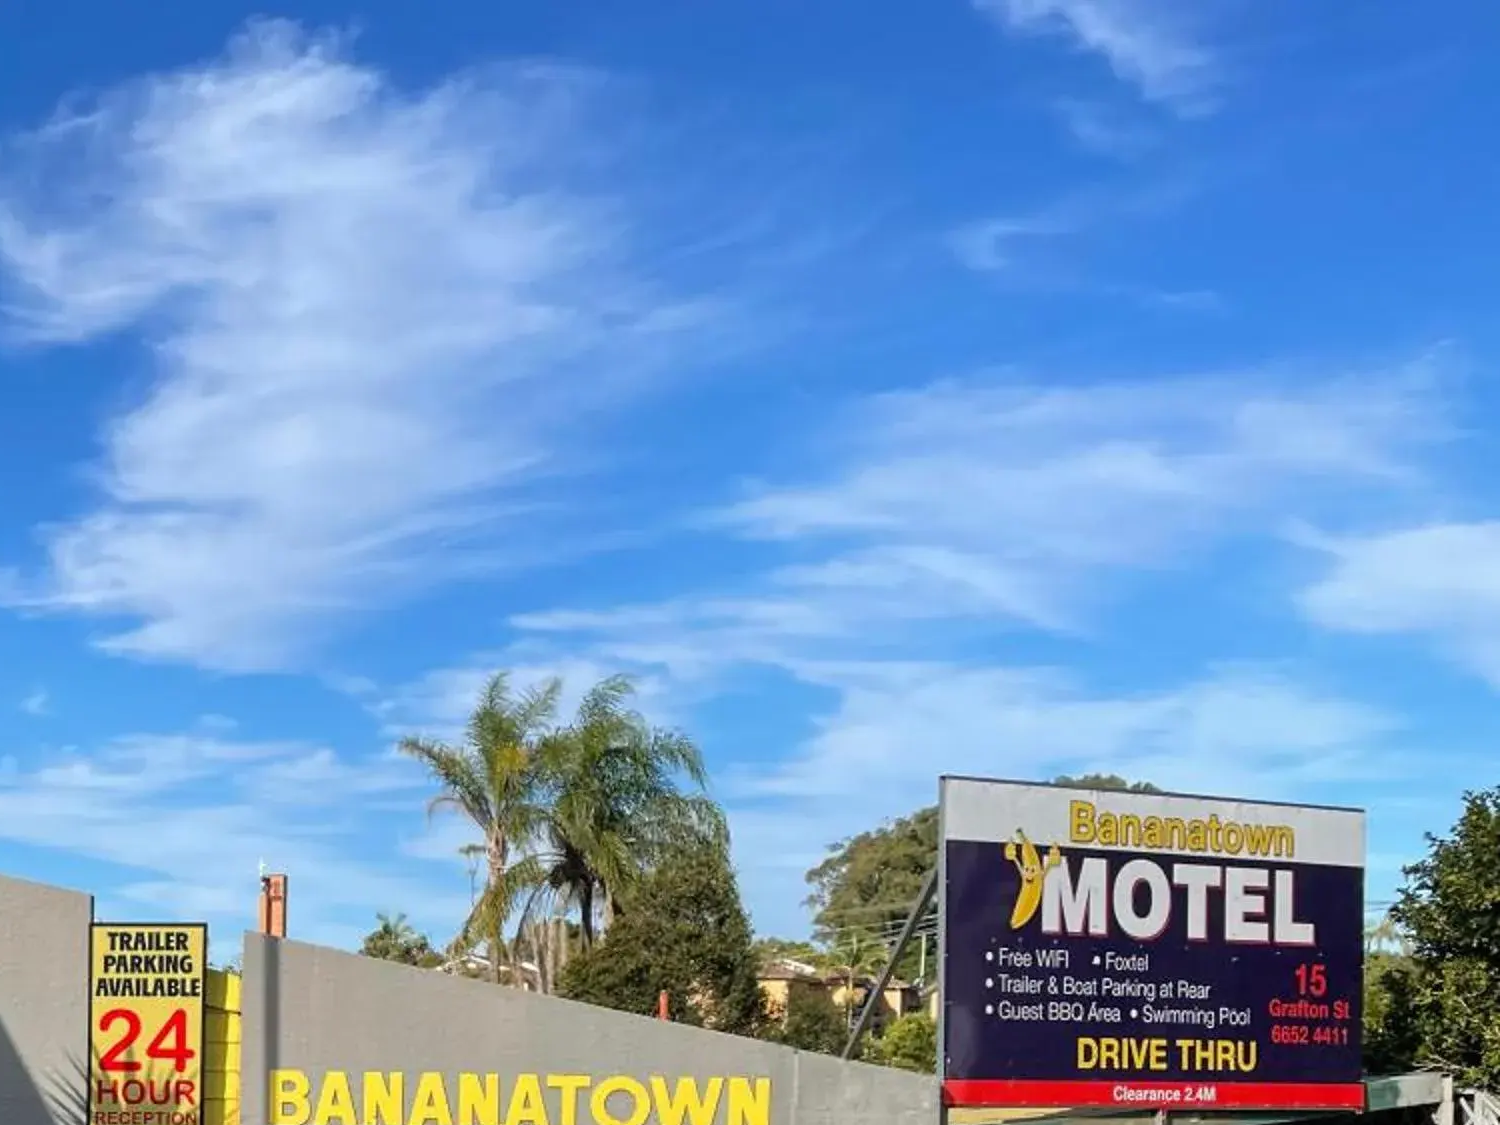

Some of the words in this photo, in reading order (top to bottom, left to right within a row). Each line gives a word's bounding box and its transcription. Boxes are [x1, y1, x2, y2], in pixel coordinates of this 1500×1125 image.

[1069, 799, 1296, 858] Bananatown
[1040, 852, 1316, 947] MOTEL
[107, 931, 189, 952] TRAILER
[103, 954, 194, 974] PARKING
[998, 948, 1033, 968] Free
[1105, 951, 1150, 972] Foxtel
[95, 977, 201, 998] AVAILABLE
[998, 973, 1045, 994] Trailer
[1047, 976, 1059, 995] &
[1063, 976, 1098, 996] Boat
[1101, 978, 1155, 1001] Parking
[1159, 981, 1174, 998] at
[1177, 980, 1212, 999] Rear
[1293, 963, 1327, 997] 15
[998, 1001, 1044, 1021] Guest
[1047, 1002, 1085, 1022] BBQ
[1087, 1003, 1121, 1023] Area
[1141, 1005, 1215, 1028] Swimming
[1219, 1007, 1251, 1026] Pool
[1268, 998, 1329, 1019] Grafton
[1331, 1000, 1351, 1019] St
[98, 1008, 196, 1073] 24
[1270, 1025, 1309, 1044] 6652
[1312, 1026, 1348, 1045] 4411
[1076, 1037, 1169, 1070] DRIVE
[1176, 1039, 1259, 1072] THRU
[96, 1079, 196, 1106] HOUR
[1113, 1086, 1181, 1101] Clearance
[1184, 1087, 1217, 1101] 2.4M
[94, 1111, 198, 1125] RECEPTION
